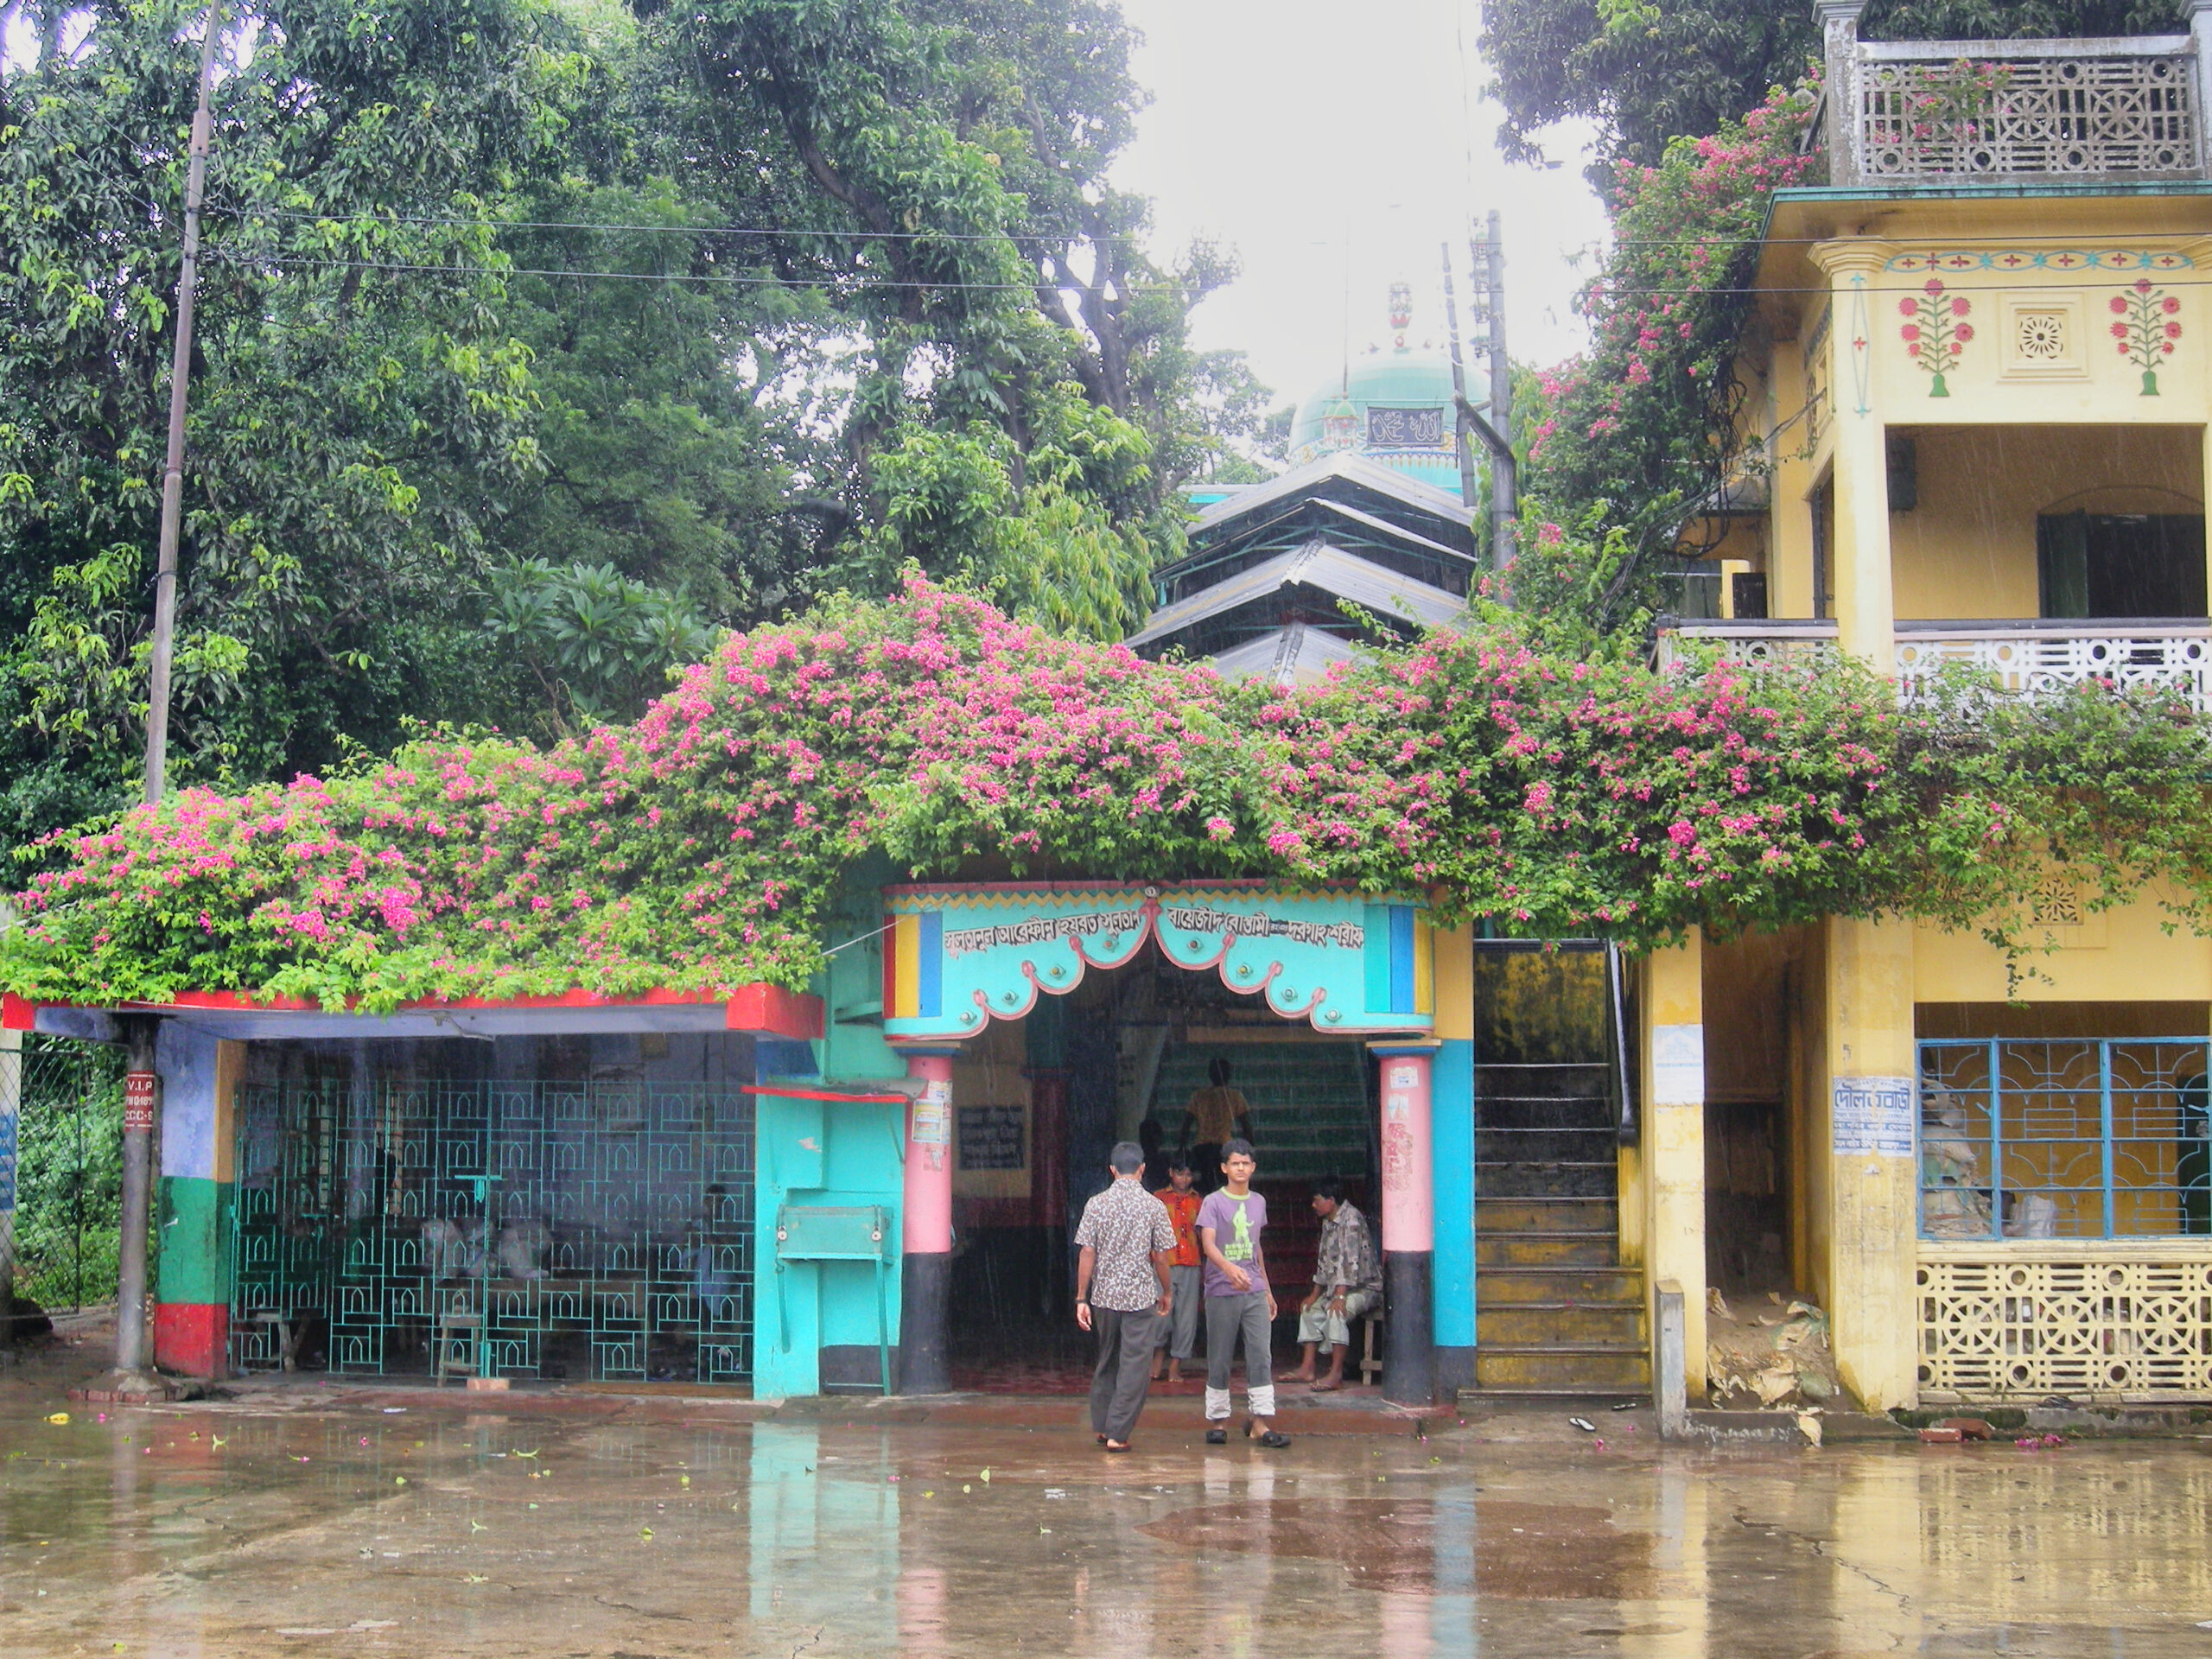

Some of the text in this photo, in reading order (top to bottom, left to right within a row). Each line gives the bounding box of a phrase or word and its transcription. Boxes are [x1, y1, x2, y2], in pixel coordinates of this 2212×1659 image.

[1058, 914, 1099, 937] হযরত
[1167, 906, 1223, 933] বায়েজীদ
[1288, 921, 1328, 947] দরগাহ
[1328, 920, 1364, 950] শরীফ
[128, 1080, 153, 1091] V.I.P
